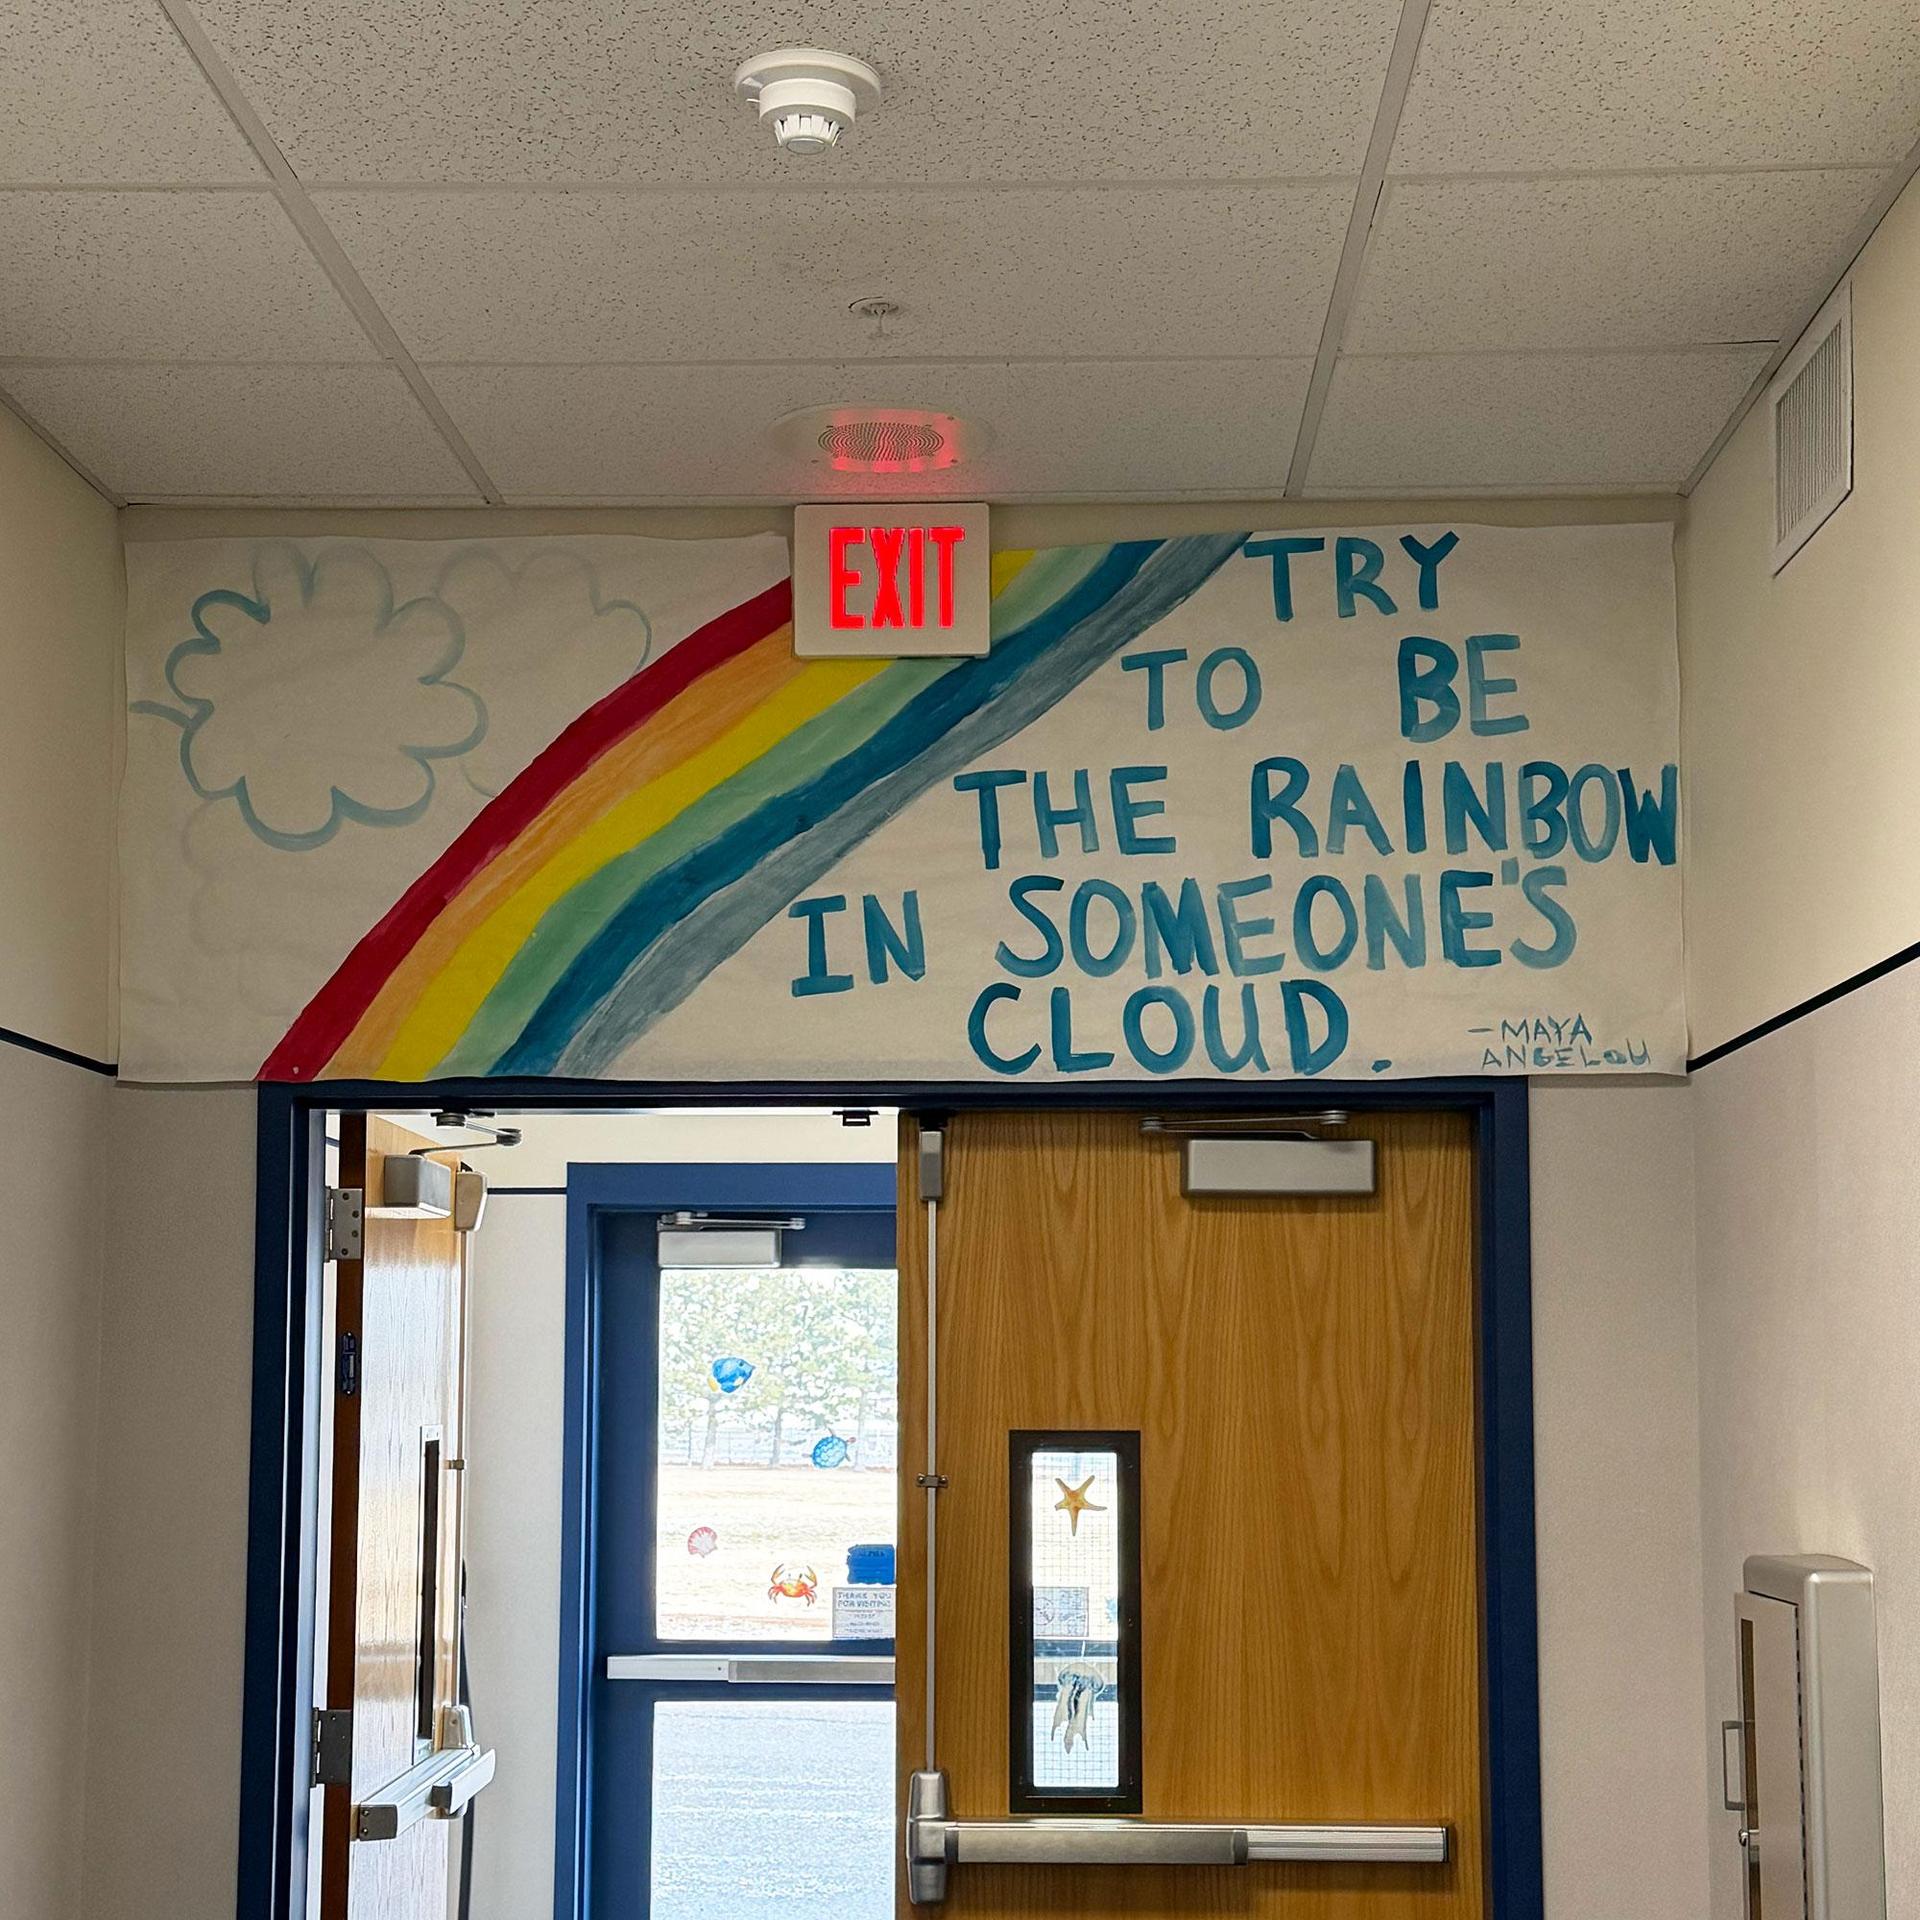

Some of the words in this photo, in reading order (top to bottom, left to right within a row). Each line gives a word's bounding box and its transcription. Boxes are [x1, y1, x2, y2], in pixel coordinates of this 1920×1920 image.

[828, 525, 966, 631] EXIT
[1243, 531, 1460, 622] TRY
[1121, 647, 1262, 731] TO
[1398, 634, 1530, 743] BE
[953, 766, 1177, 869] THE
[1250, 757, 1677, 866] RAINBOW
[790, 890, 926, 997] IN
[994, 857, 1577, 978] SOMEONE'S
[968, 980, 1392, 1077] CLOUD.
[1482, 1038, 1650, 1070] ANGELOU
